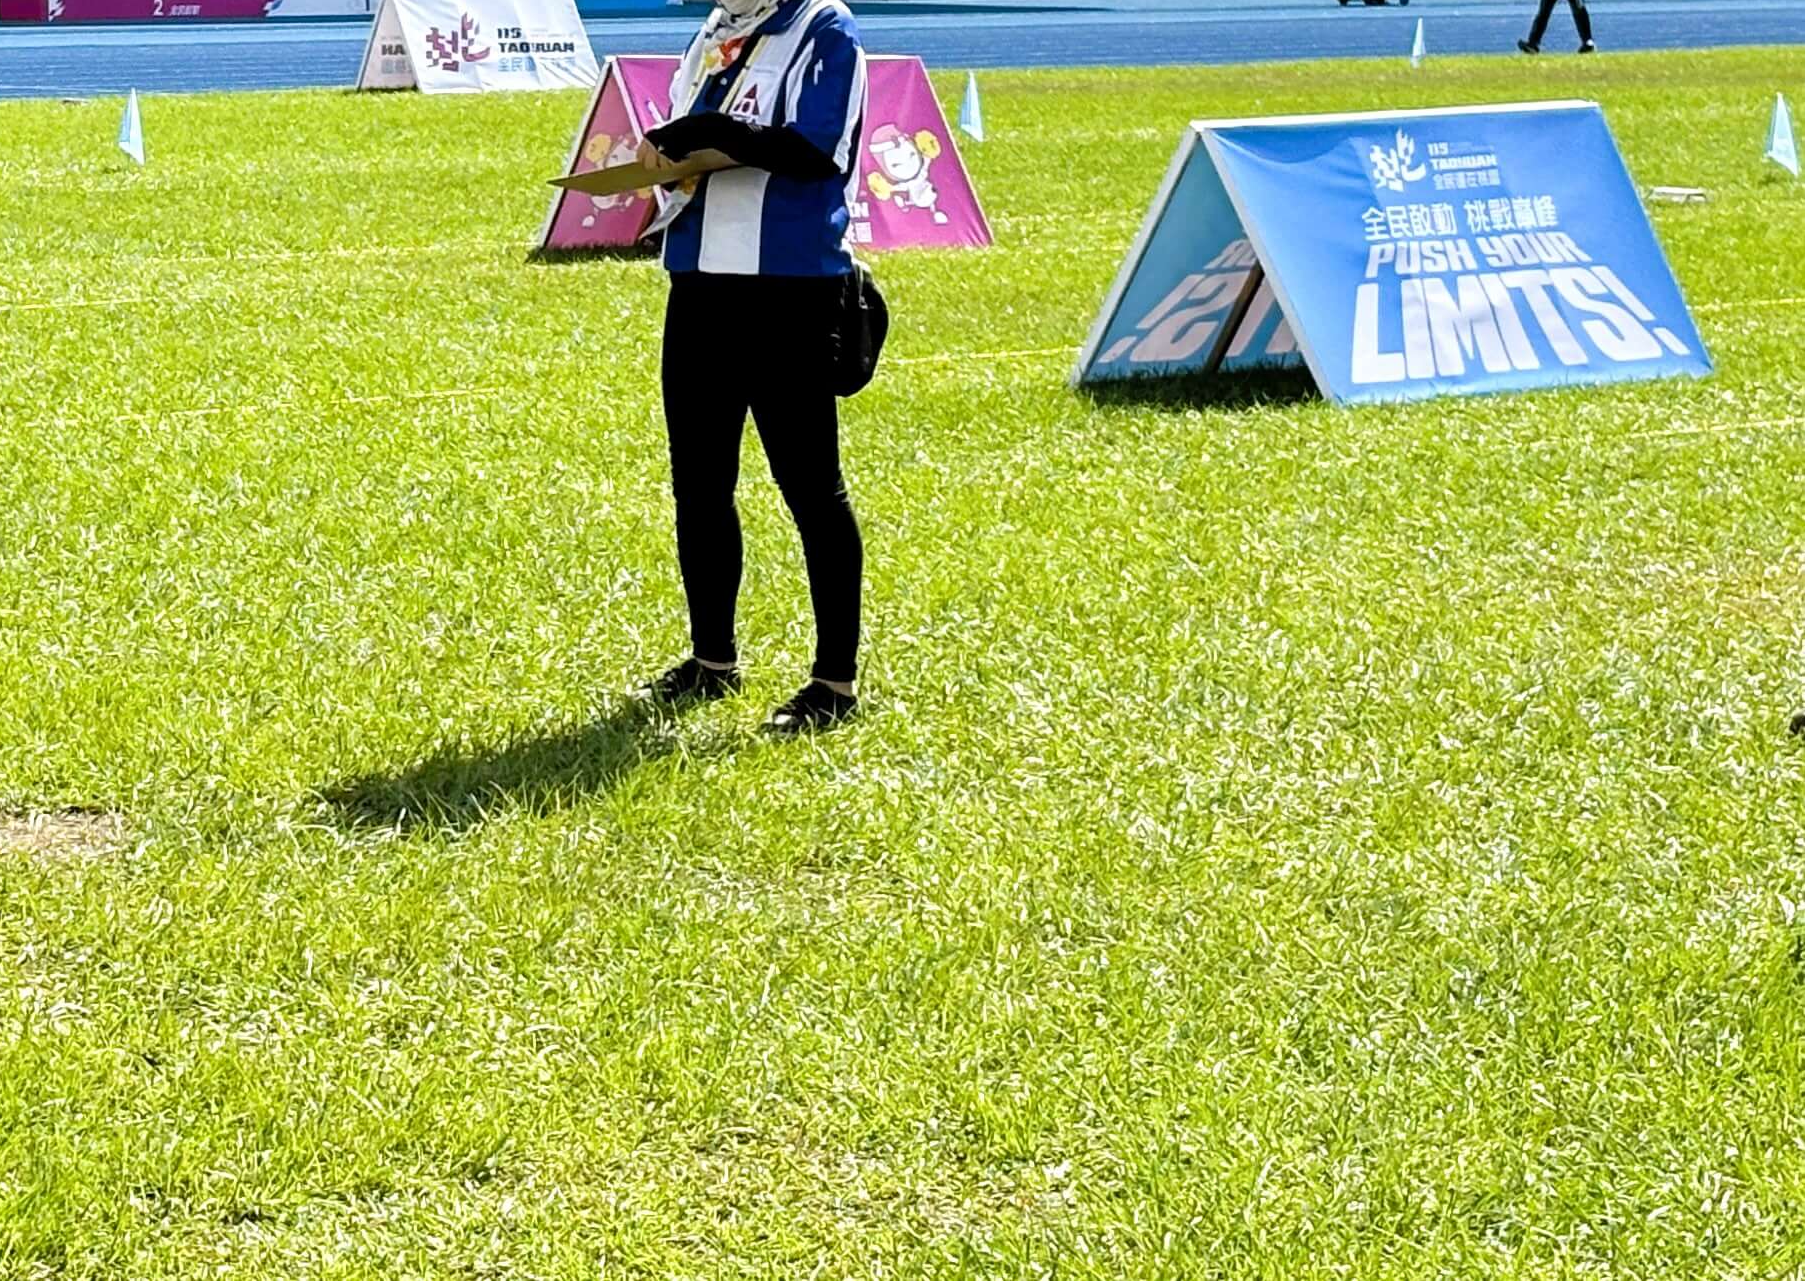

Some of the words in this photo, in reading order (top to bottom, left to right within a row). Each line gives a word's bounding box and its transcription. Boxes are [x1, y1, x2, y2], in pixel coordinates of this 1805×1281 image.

[497, 27, 523, 39] 115
[1427, 142, 1449, 157] 115
[1362, 203, 1458, 241] 全民敢動
[1365, 237, 1477, 278] PUSH
[1477, 231, 1593, 268] YOUR
[1351, 265, 1691, 385] LIMITS!
